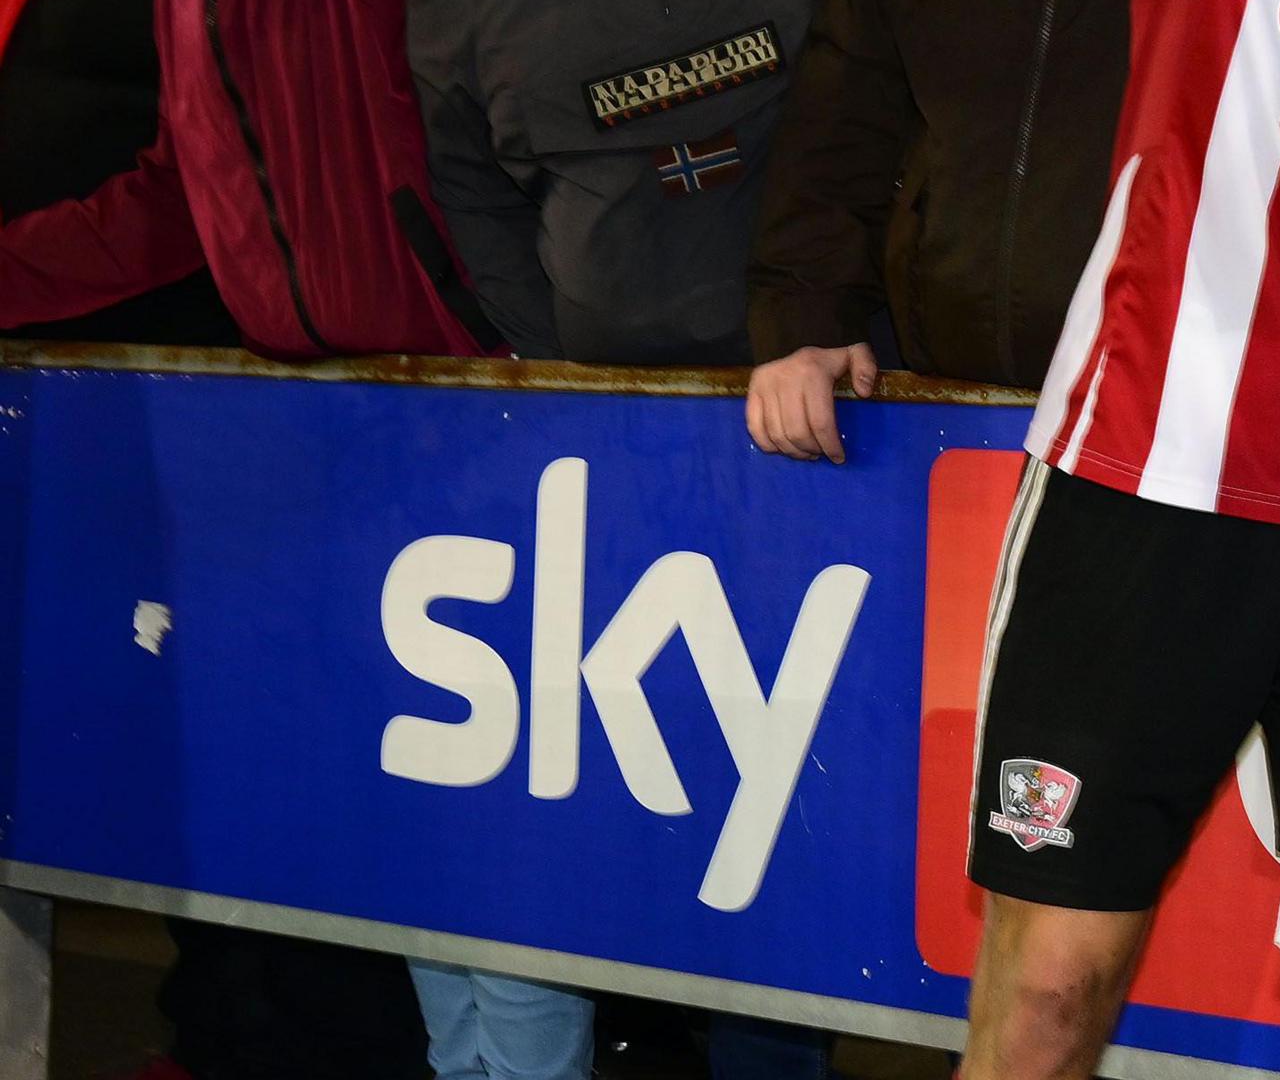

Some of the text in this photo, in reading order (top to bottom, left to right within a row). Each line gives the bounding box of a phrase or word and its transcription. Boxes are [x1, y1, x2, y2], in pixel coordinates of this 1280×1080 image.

[594, 31, 776, 115] NAPAPIJRI
[380, 457, 872, 914] sky
[992, 816, 1066, 841] EXETER CITY FC
